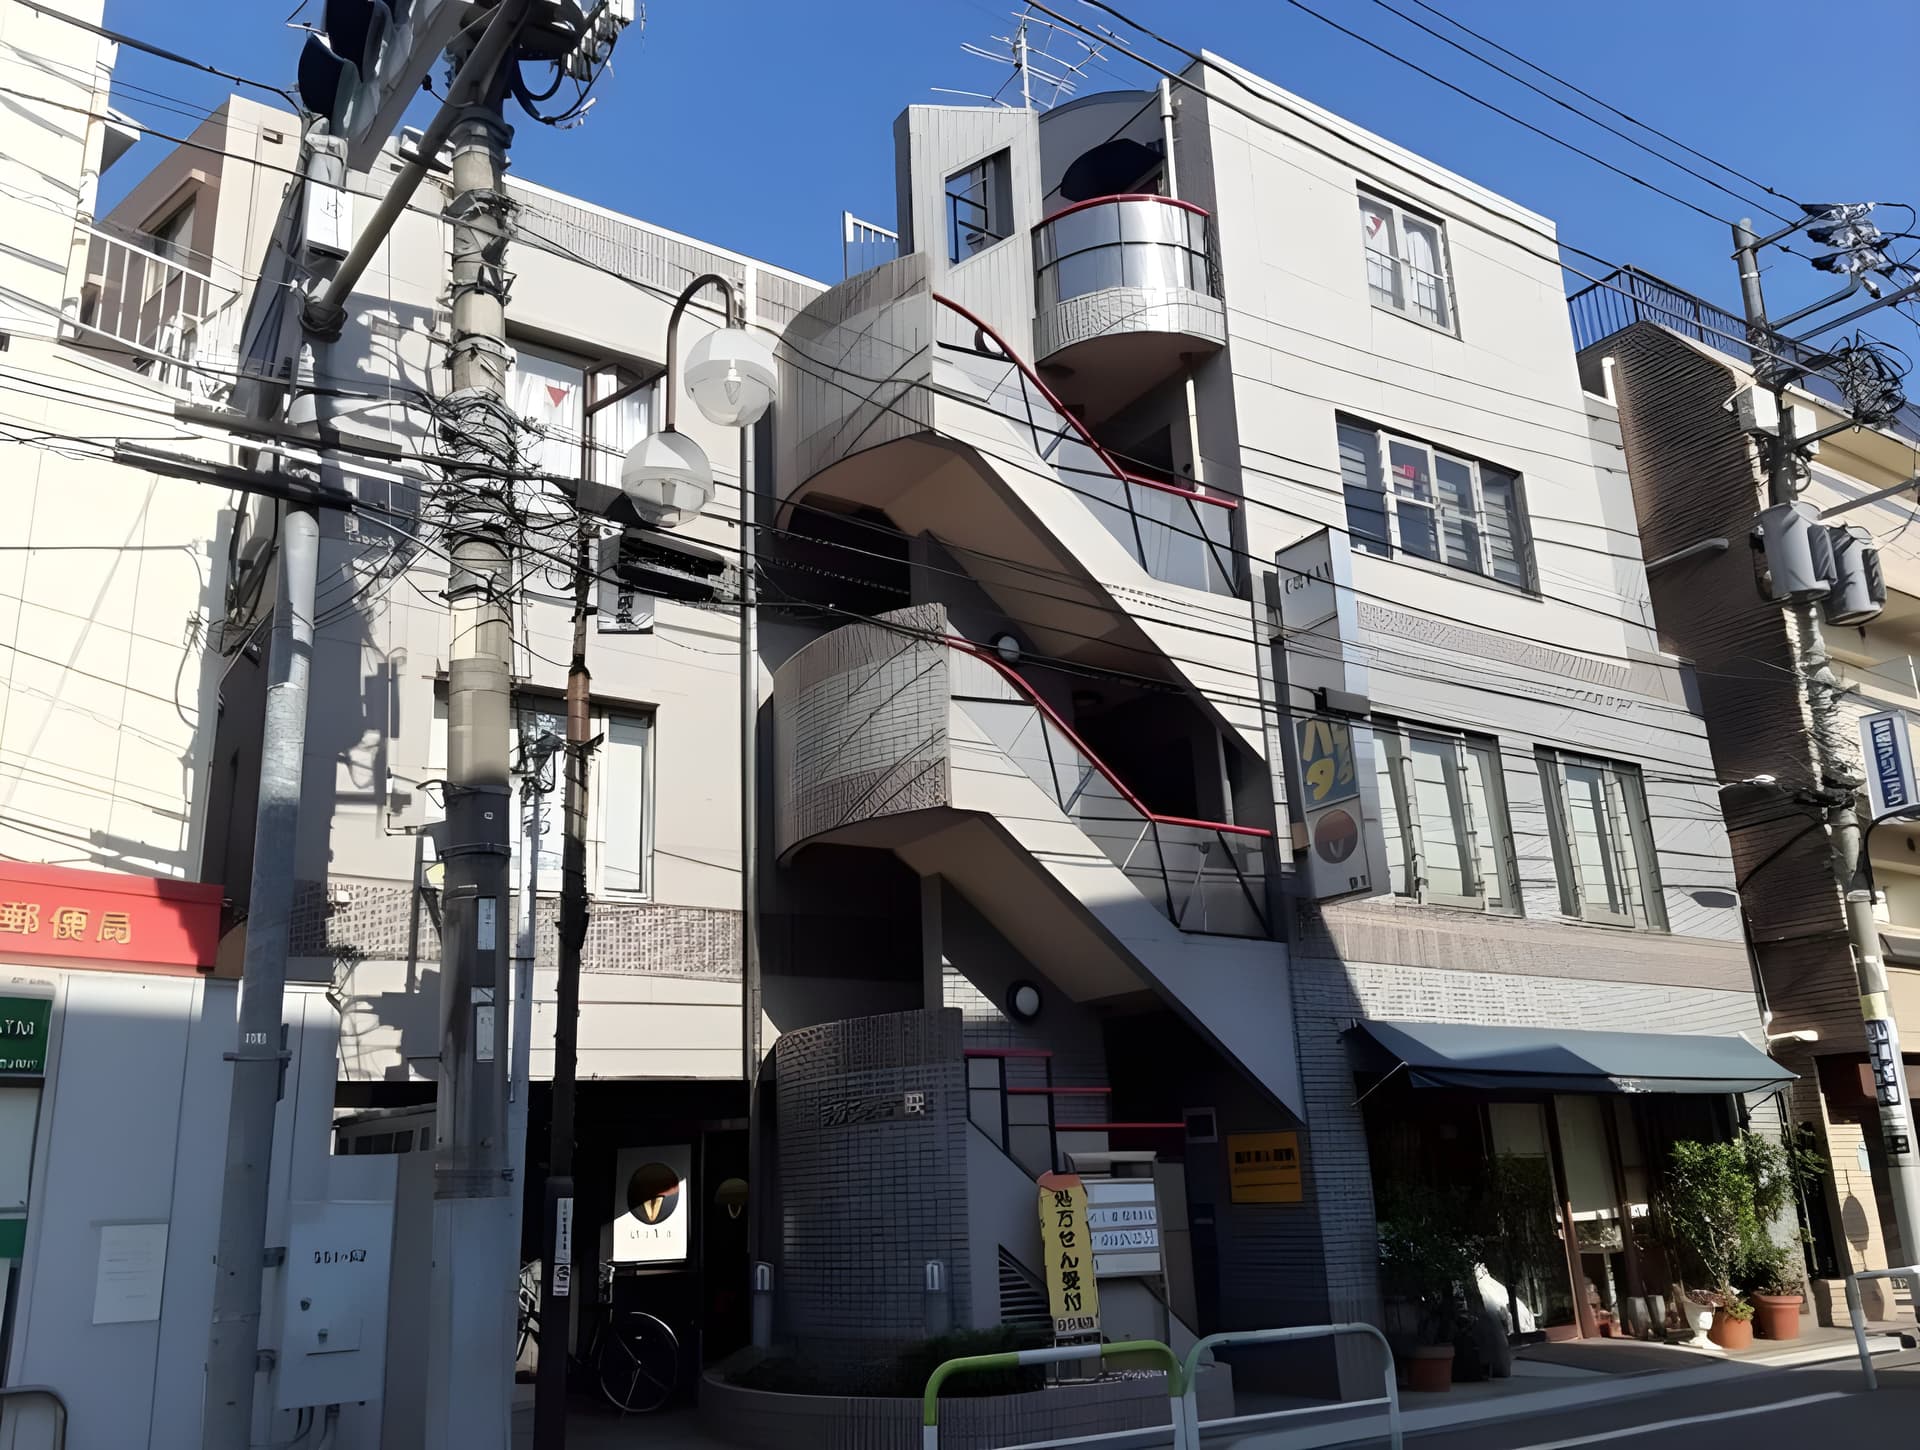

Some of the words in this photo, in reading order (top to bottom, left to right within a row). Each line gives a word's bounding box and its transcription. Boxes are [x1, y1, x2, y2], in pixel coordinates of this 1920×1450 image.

[0, 901, 132, 944] 郵便局
[1054, 1188, 1082, 1312] 処方せん受付
